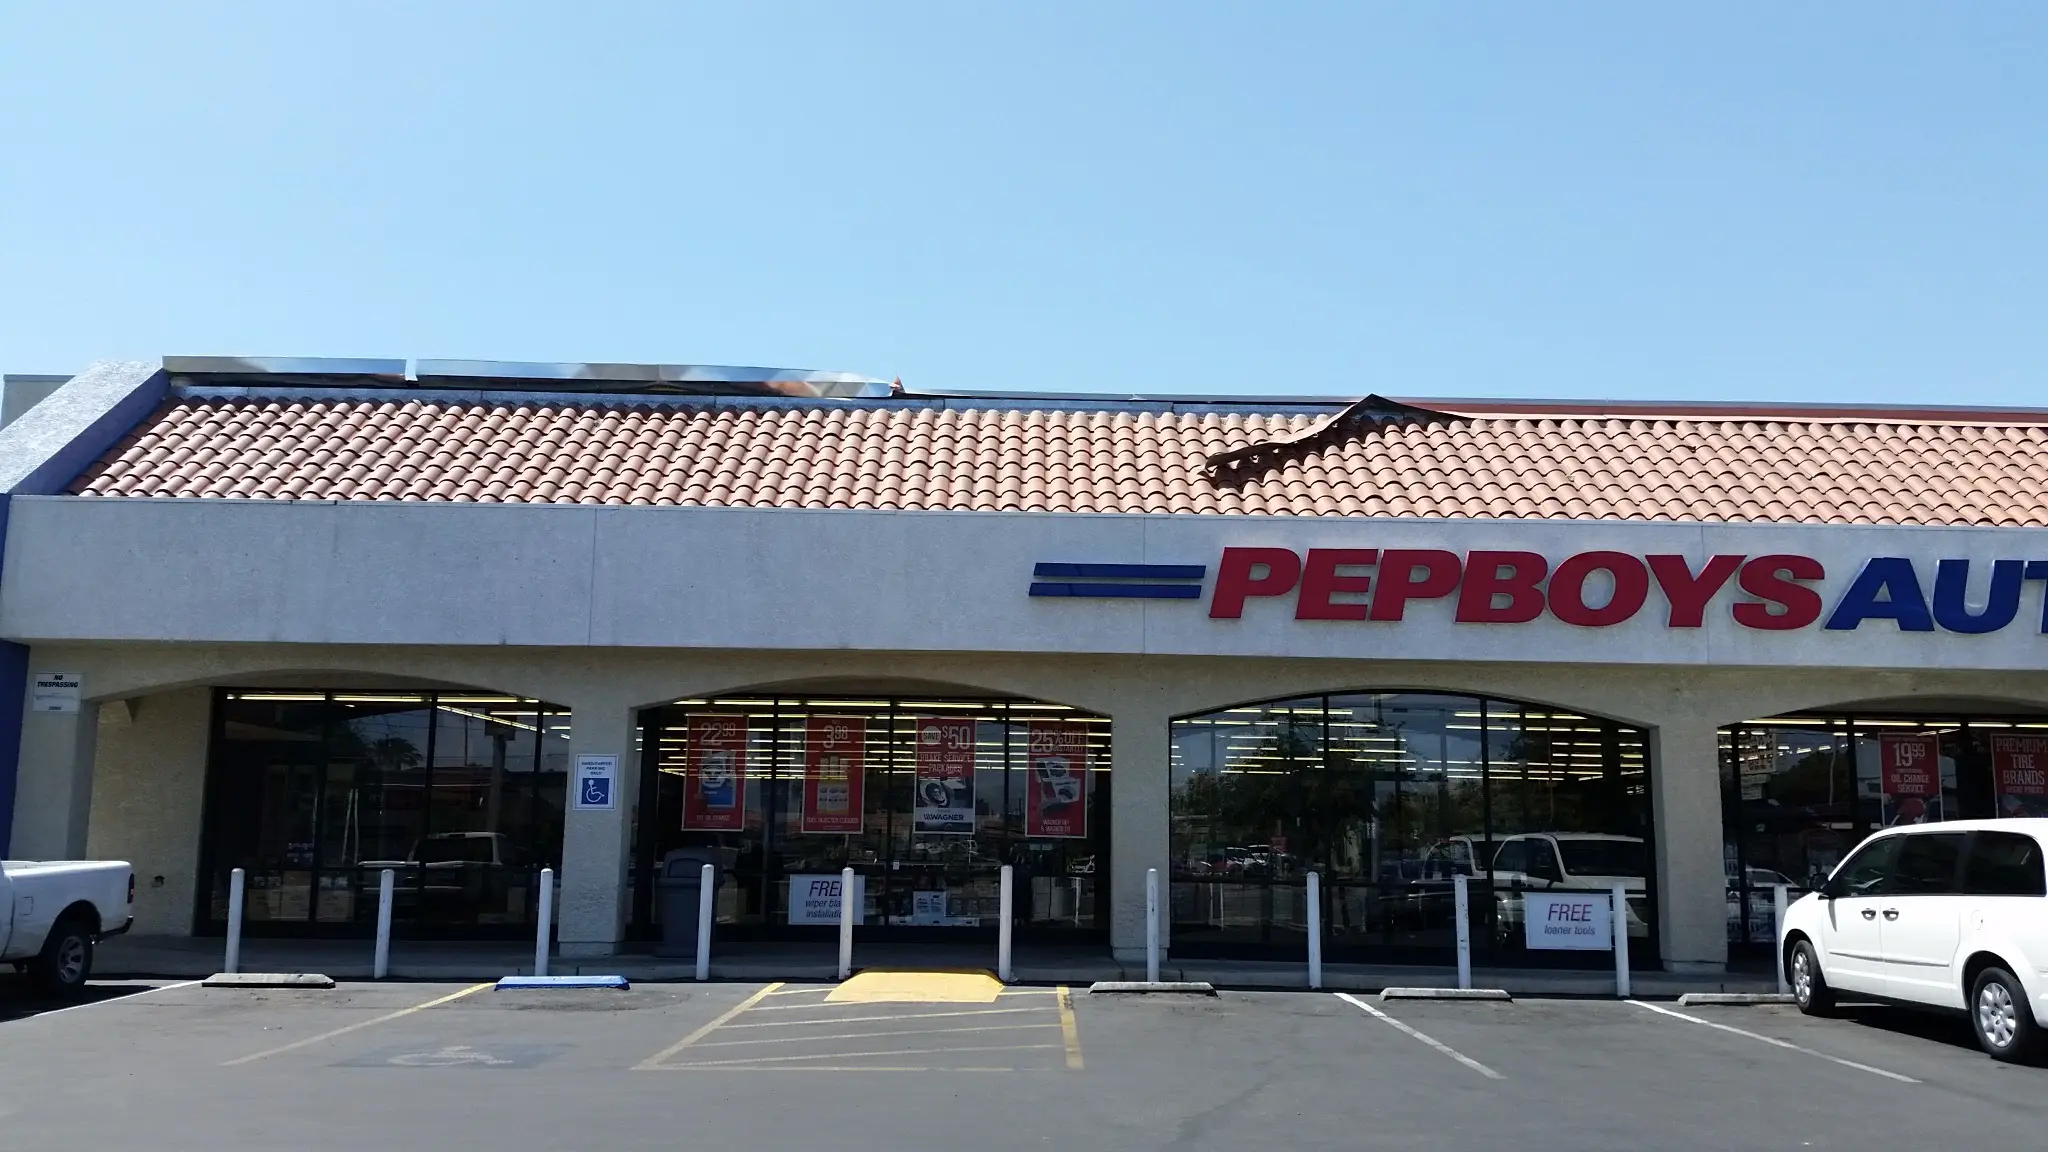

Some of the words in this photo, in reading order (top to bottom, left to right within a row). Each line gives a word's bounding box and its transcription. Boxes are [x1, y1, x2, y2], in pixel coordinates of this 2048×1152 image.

[923, 731, 939, 741] SAVE
[942, 725, 971, 750] $50
[1995, 737, 2048, 753] PREMIUM
[919, 753, 942, 762] BRAKE
[943, 753, 973, 763] SERVICE
[2010, 753, 2036, 769] TIRE
[928, 763, 963, 774] PACKAGES
[1891, 773, 1903, 783] OIL
[1903, 774, 1931, 784] CHANGE
[2002, 769, 2046, 786] BRANDS
[1897, 784, 1926, 794] SERVICE
[930, 813, 965, 821] WAGNER
[809, 880, 843, 898] FRE
[805, 900, 828, 908] wiper
[828, 899, 842, 908] bla
[806, 909, 842, 919] installati
[1548, 904, 1593, 921] FREE
[1544, 925, 1573, 935] loaner
[1574, 926, 1596, 936] tools
